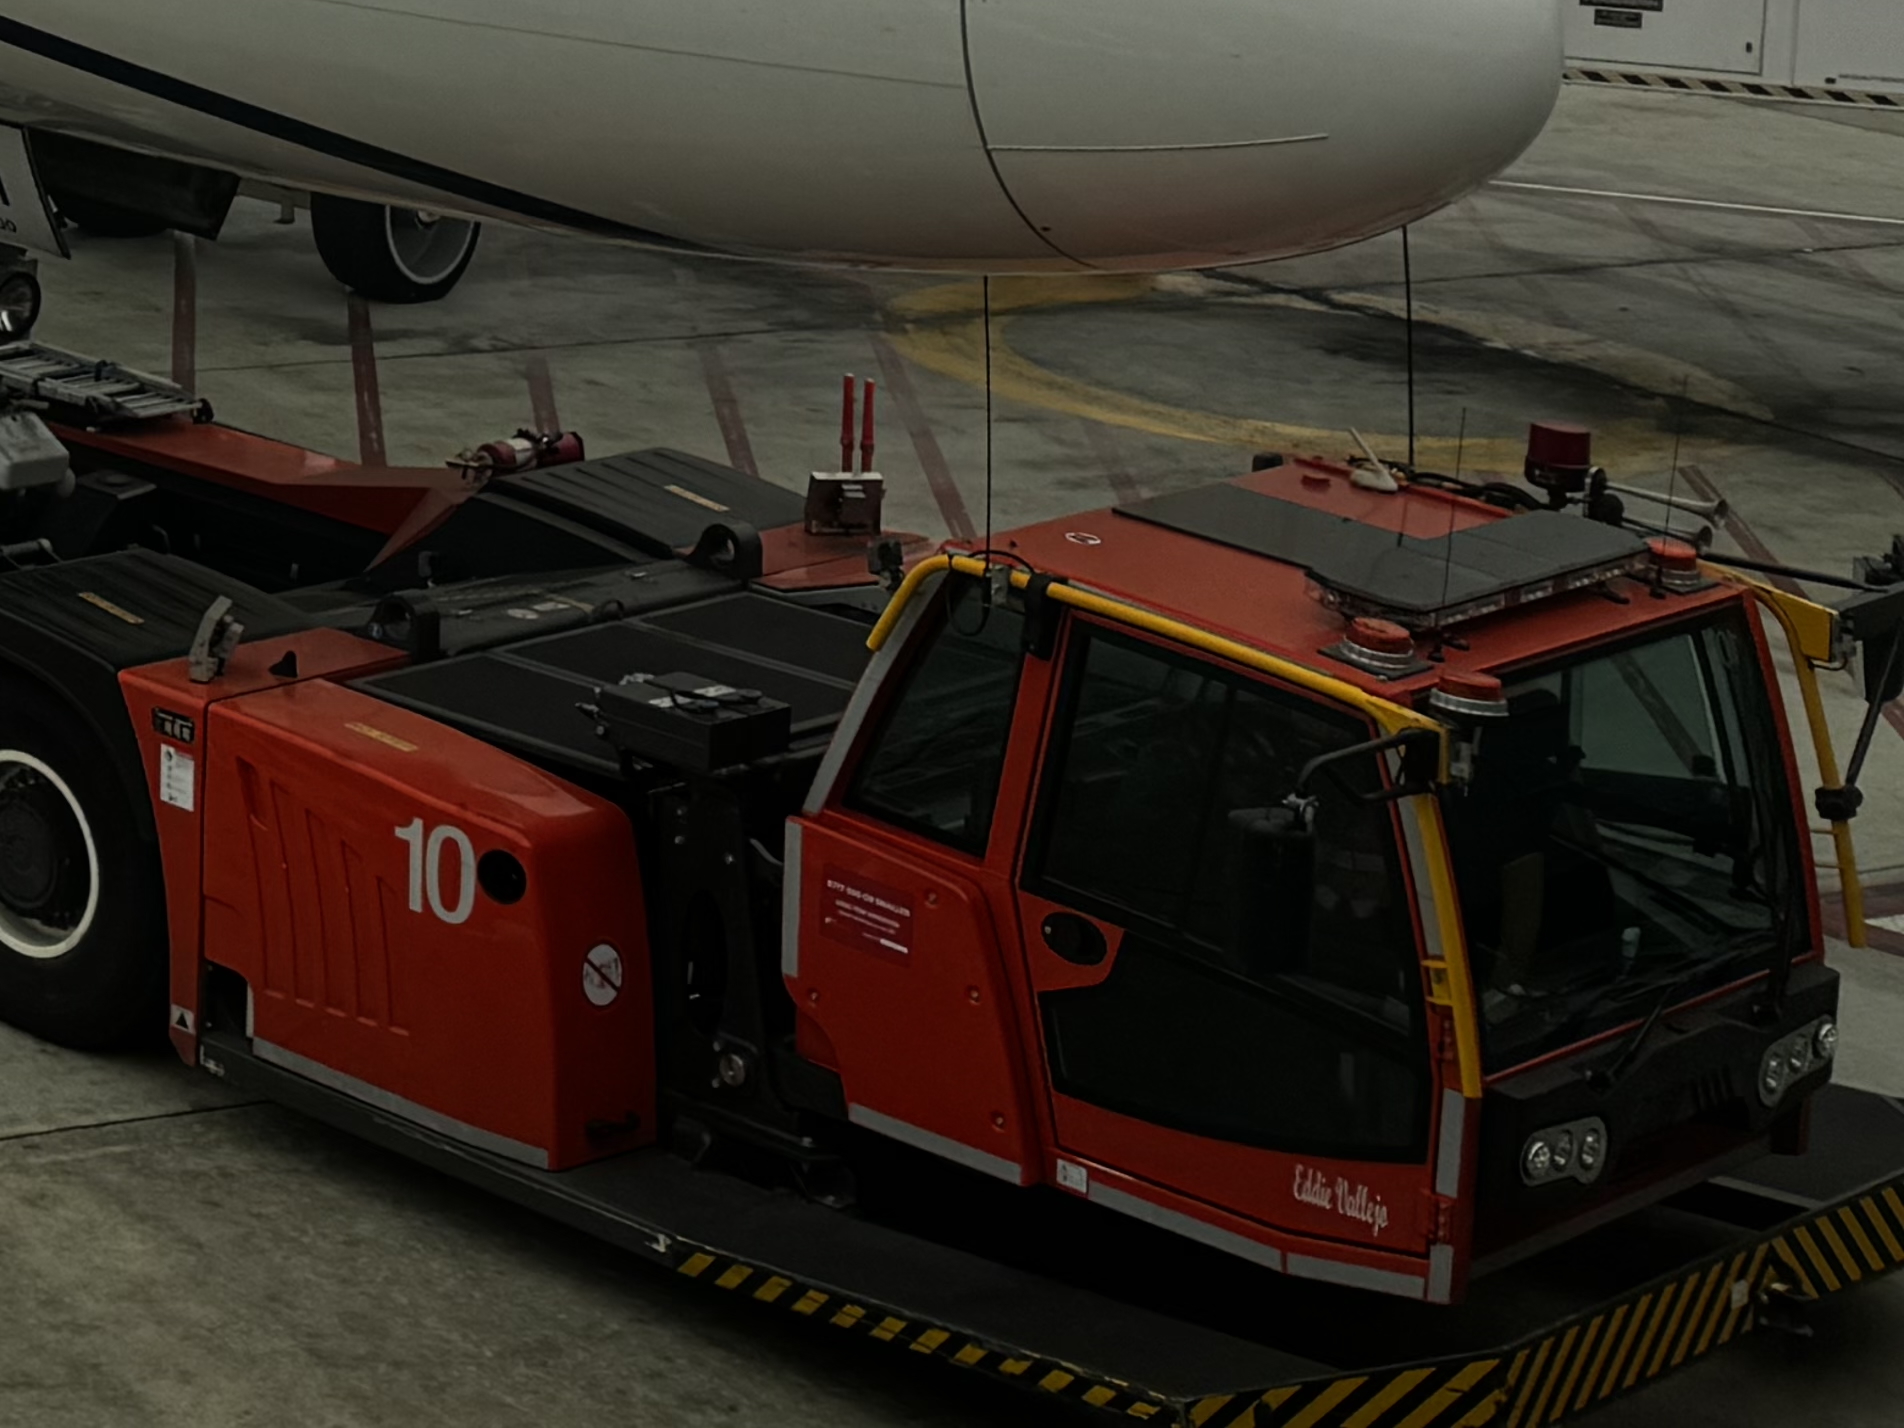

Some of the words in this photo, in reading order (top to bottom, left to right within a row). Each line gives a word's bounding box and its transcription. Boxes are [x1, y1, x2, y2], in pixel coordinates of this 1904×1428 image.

[394, 817, 476, 926] 10
[1293, 1163, 1333, 1210] Eddie
[1335, 1176, 1389, 1238] Vallejo
